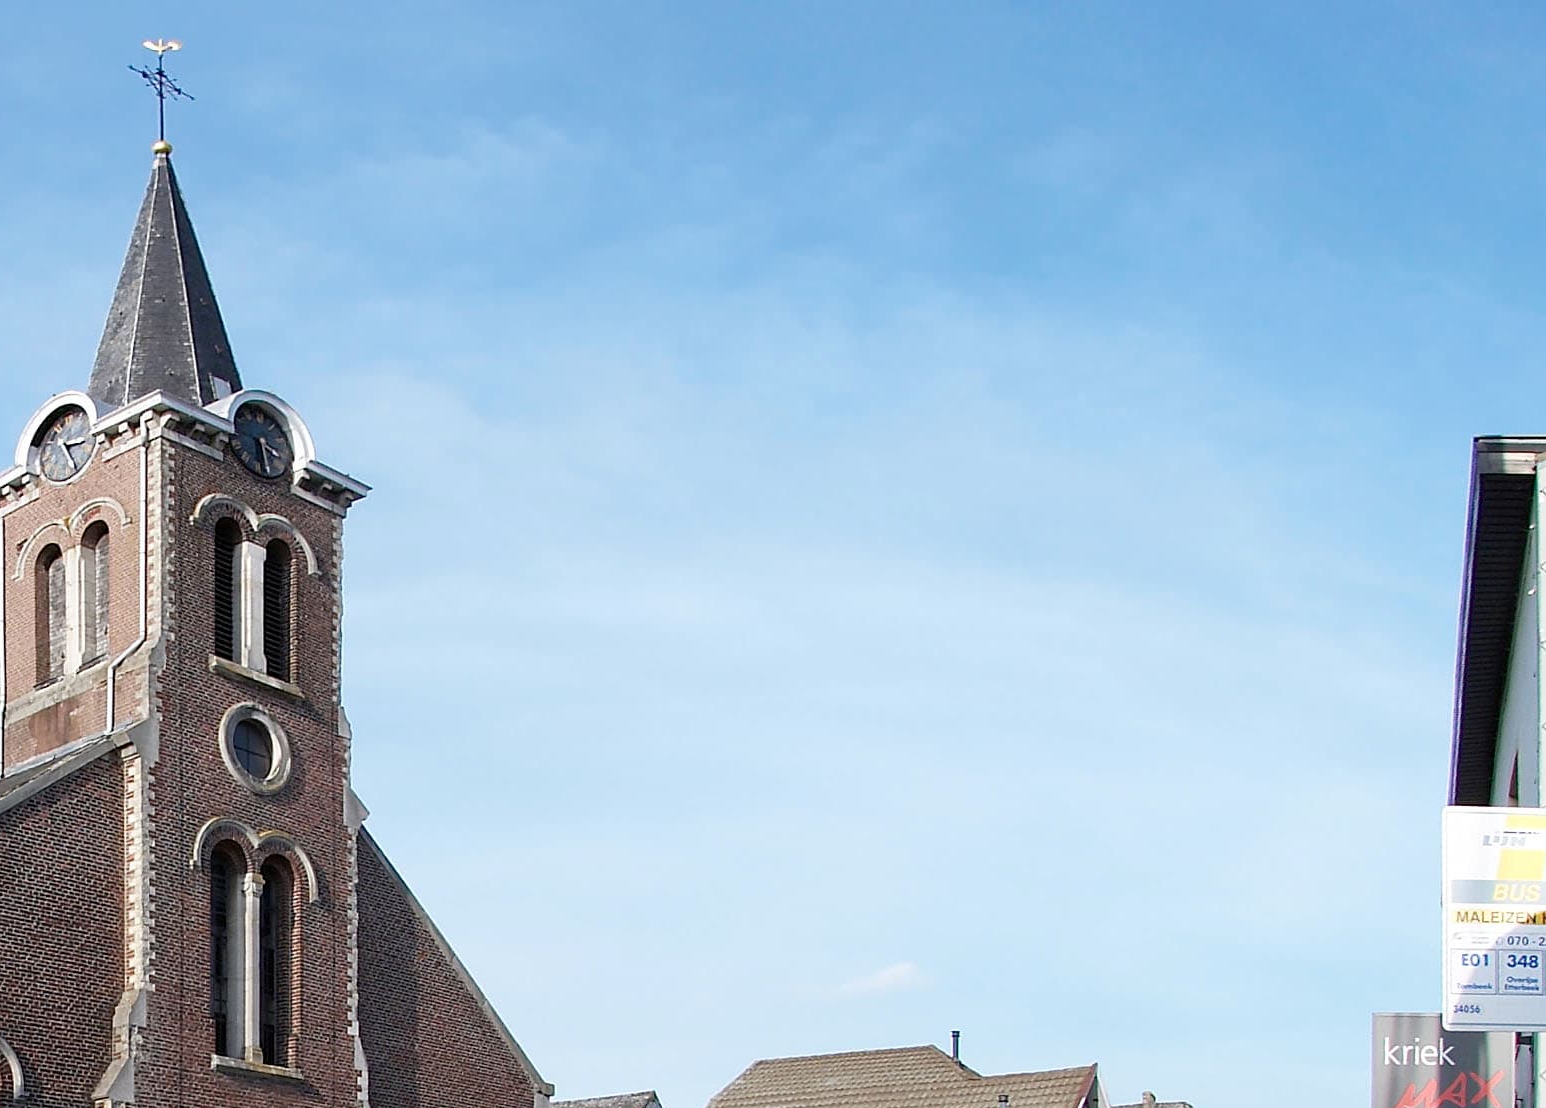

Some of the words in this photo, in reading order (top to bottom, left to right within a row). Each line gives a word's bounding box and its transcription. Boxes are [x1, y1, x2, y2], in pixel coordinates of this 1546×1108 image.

[1493, 883, 1541, 902] BUS
[1456, 911, 1536, 925] MALEIZEN
[1507, 935, 1529, 946] 070
[1506, 954, 1539, 968] 348
[1384, 1037, 1456, 1065] kriek
